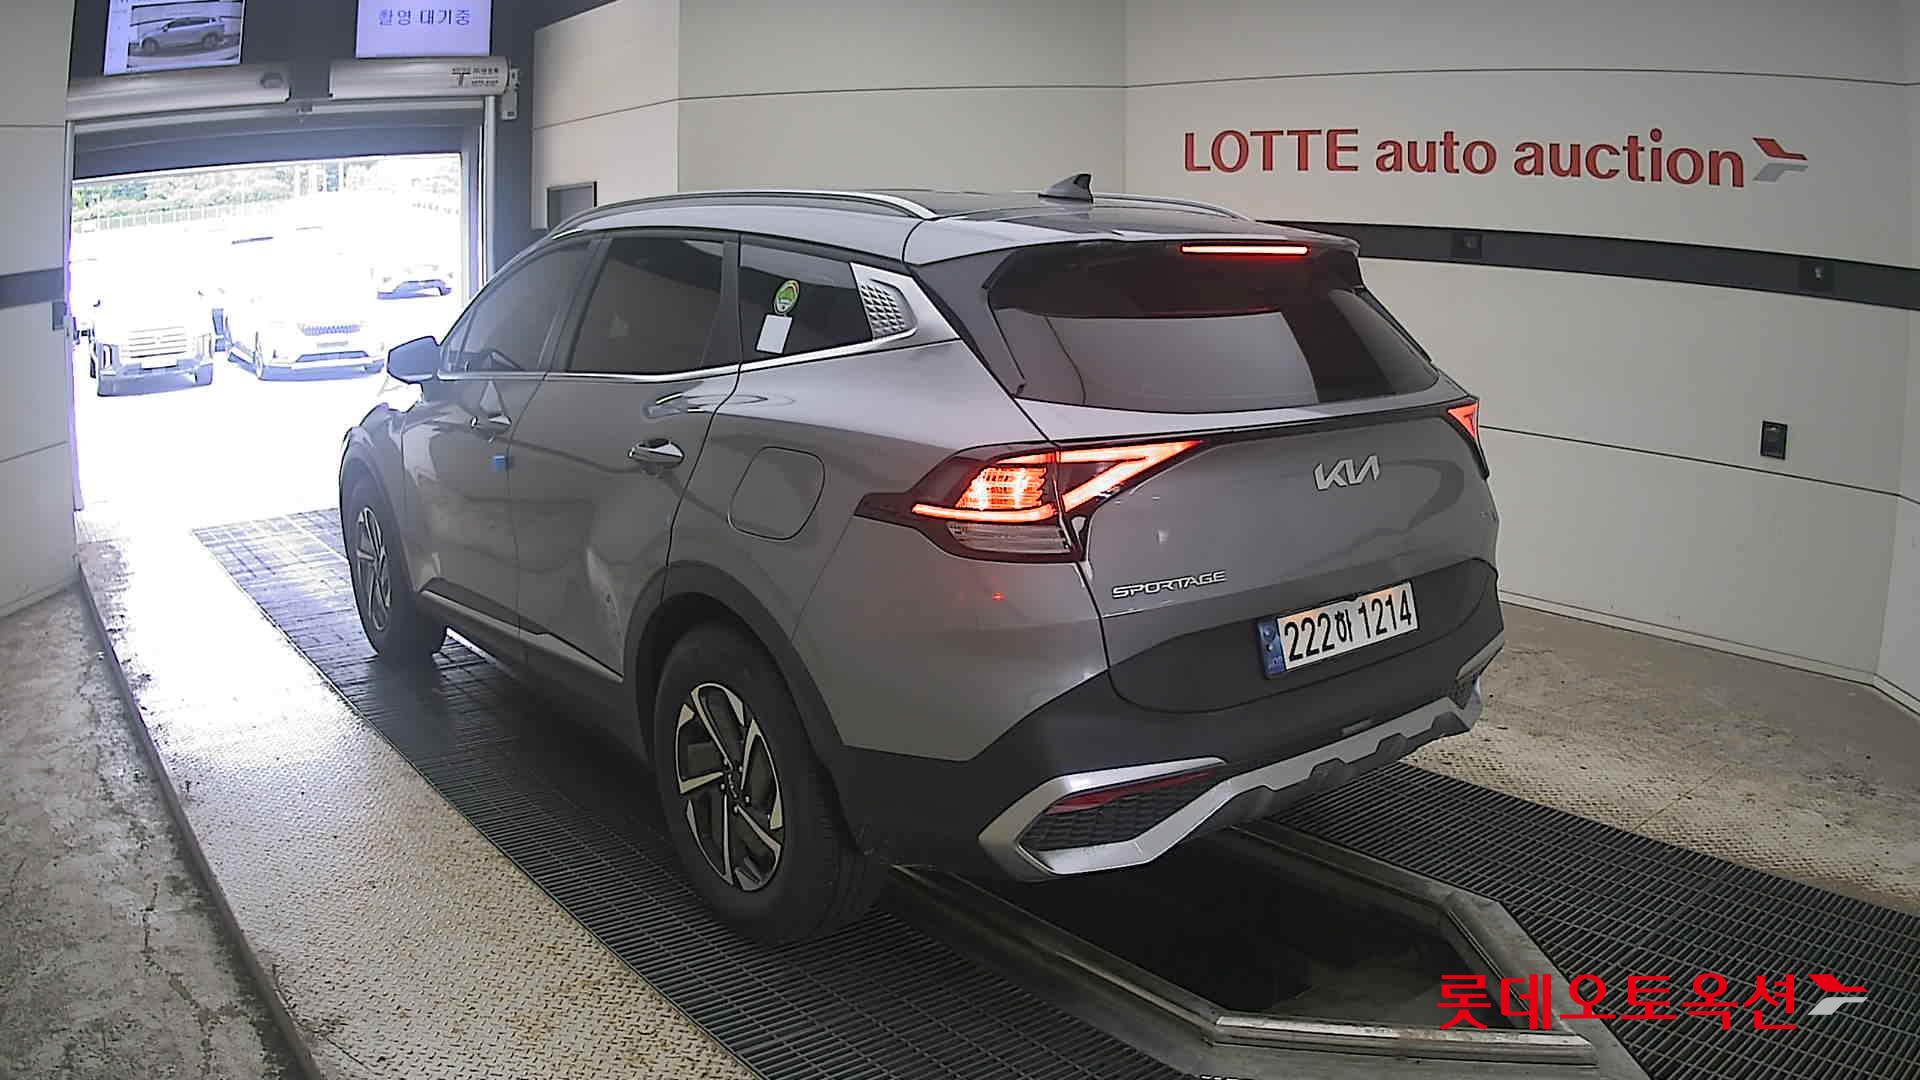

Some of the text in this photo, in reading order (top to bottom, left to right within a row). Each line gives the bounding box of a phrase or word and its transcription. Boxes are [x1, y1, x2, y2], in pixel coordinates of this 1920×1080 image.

[420, 9, 471, 26] 대기중
[1184, 128, 1744, 187] LOTTE auto auction
[1313, 455, 1380, 490] KIA
[1112, 569, 1226, 599] SPORTAGE
[1284, 589, 1412, 662] 222하 1214
